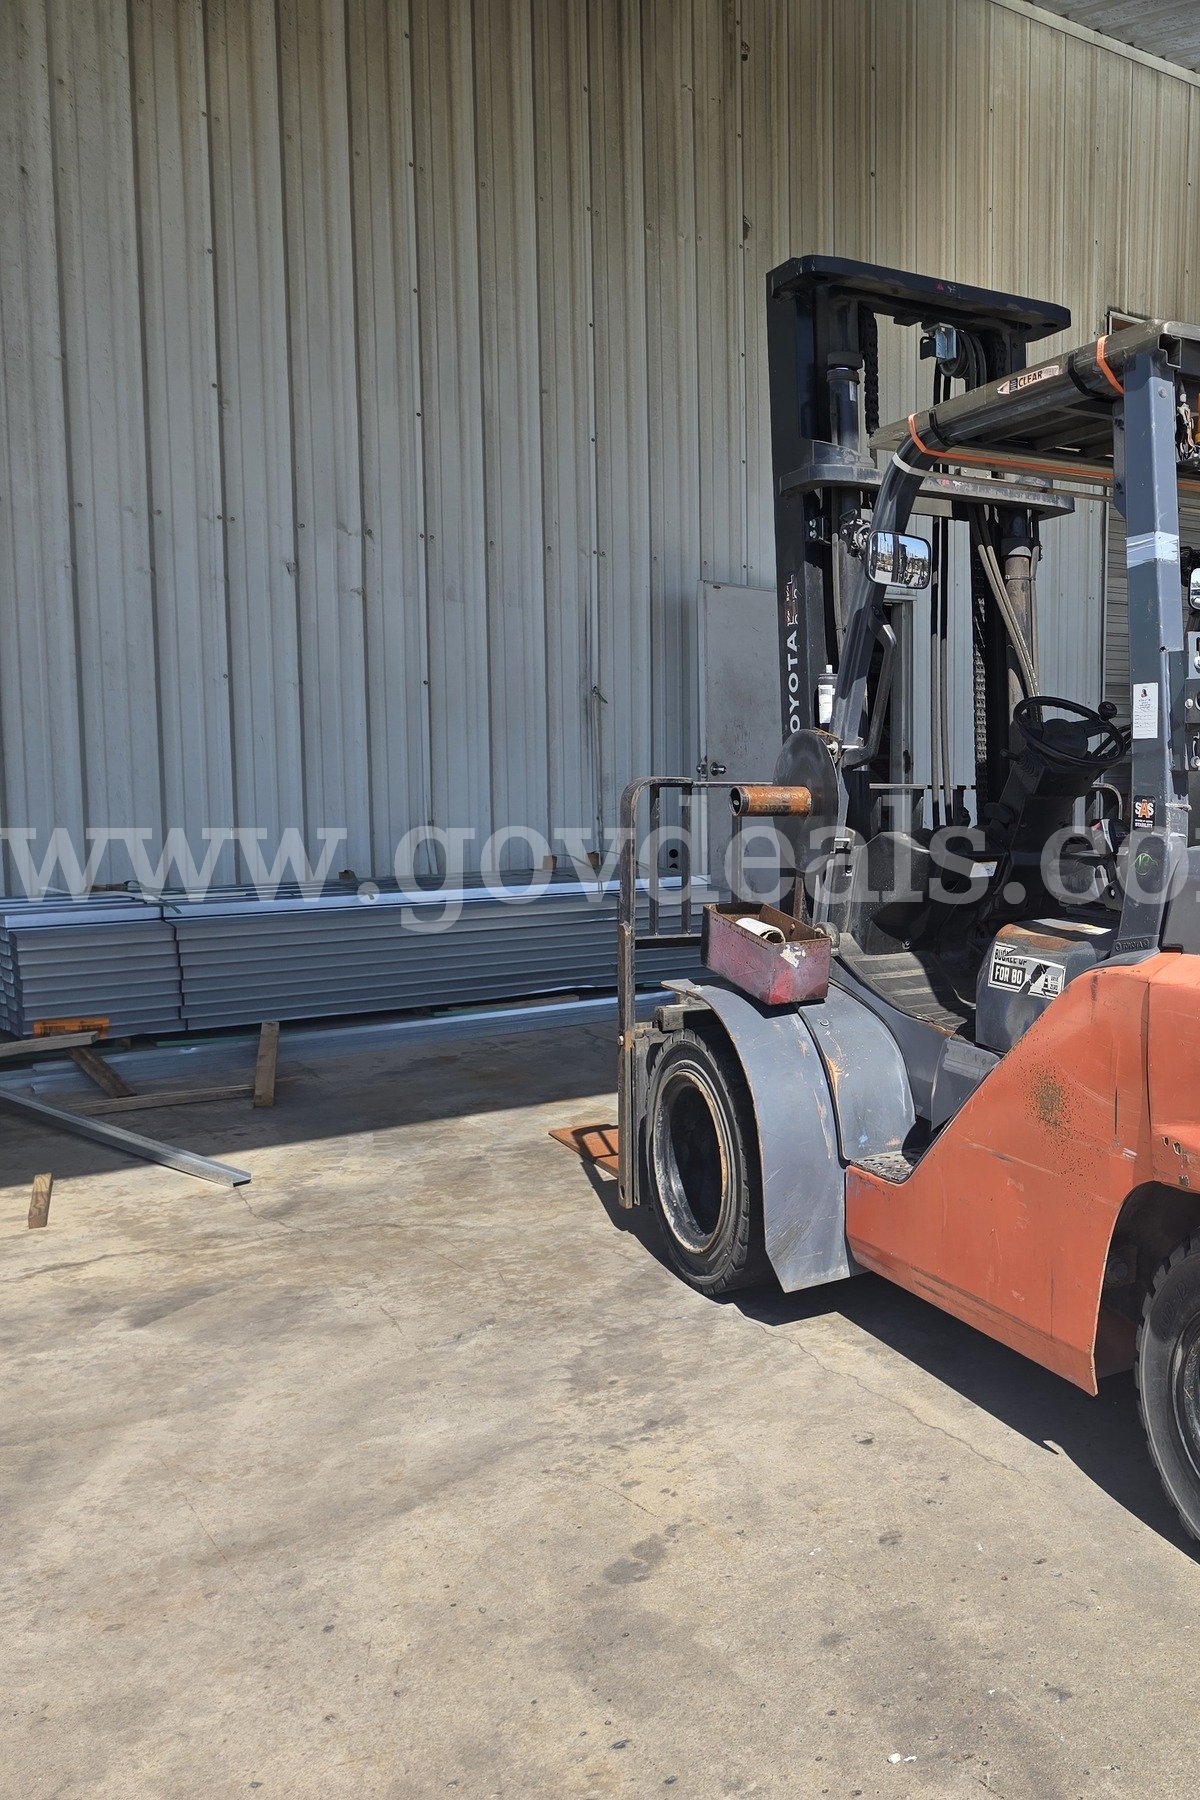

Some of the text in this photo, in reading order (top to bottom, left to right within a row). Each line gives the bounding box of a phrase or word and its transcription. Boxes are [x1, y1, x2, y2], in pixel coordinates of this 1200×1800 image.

[1018, 370, 1043, 388] CLEAR
[786, 630, 801, 734] OYOTA
[1134, 798, 1155, 819] SAS
[995, 965, 1010, 983] FOR
